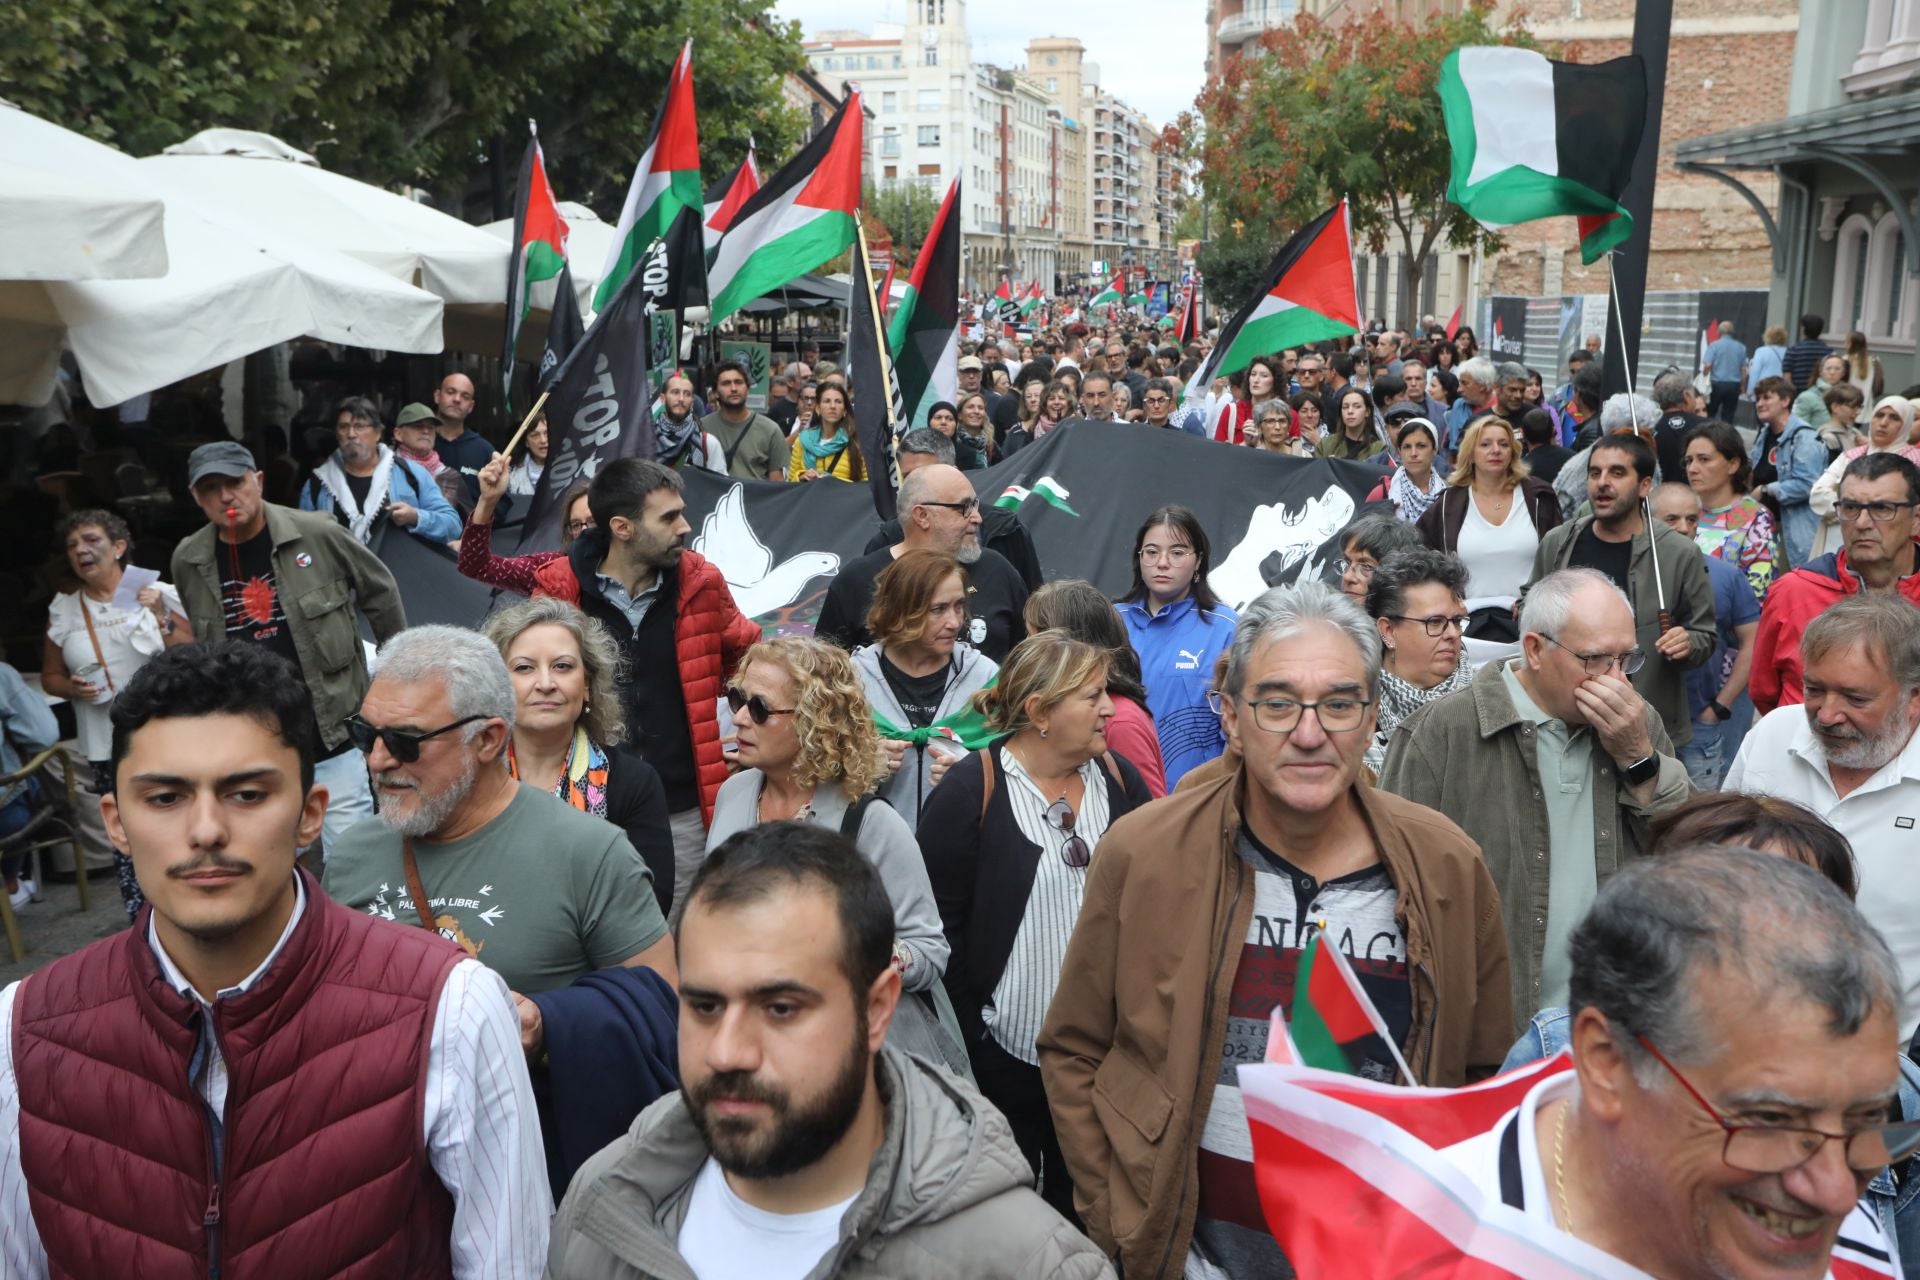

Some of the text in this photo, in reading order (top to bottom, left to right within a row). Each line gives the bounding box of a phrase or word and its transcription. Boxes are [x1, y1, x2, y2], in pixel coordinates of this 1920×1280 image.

[643, 242, 669, 297] STOP
[398, 897, 480, 909] PALTINA LIBRE
